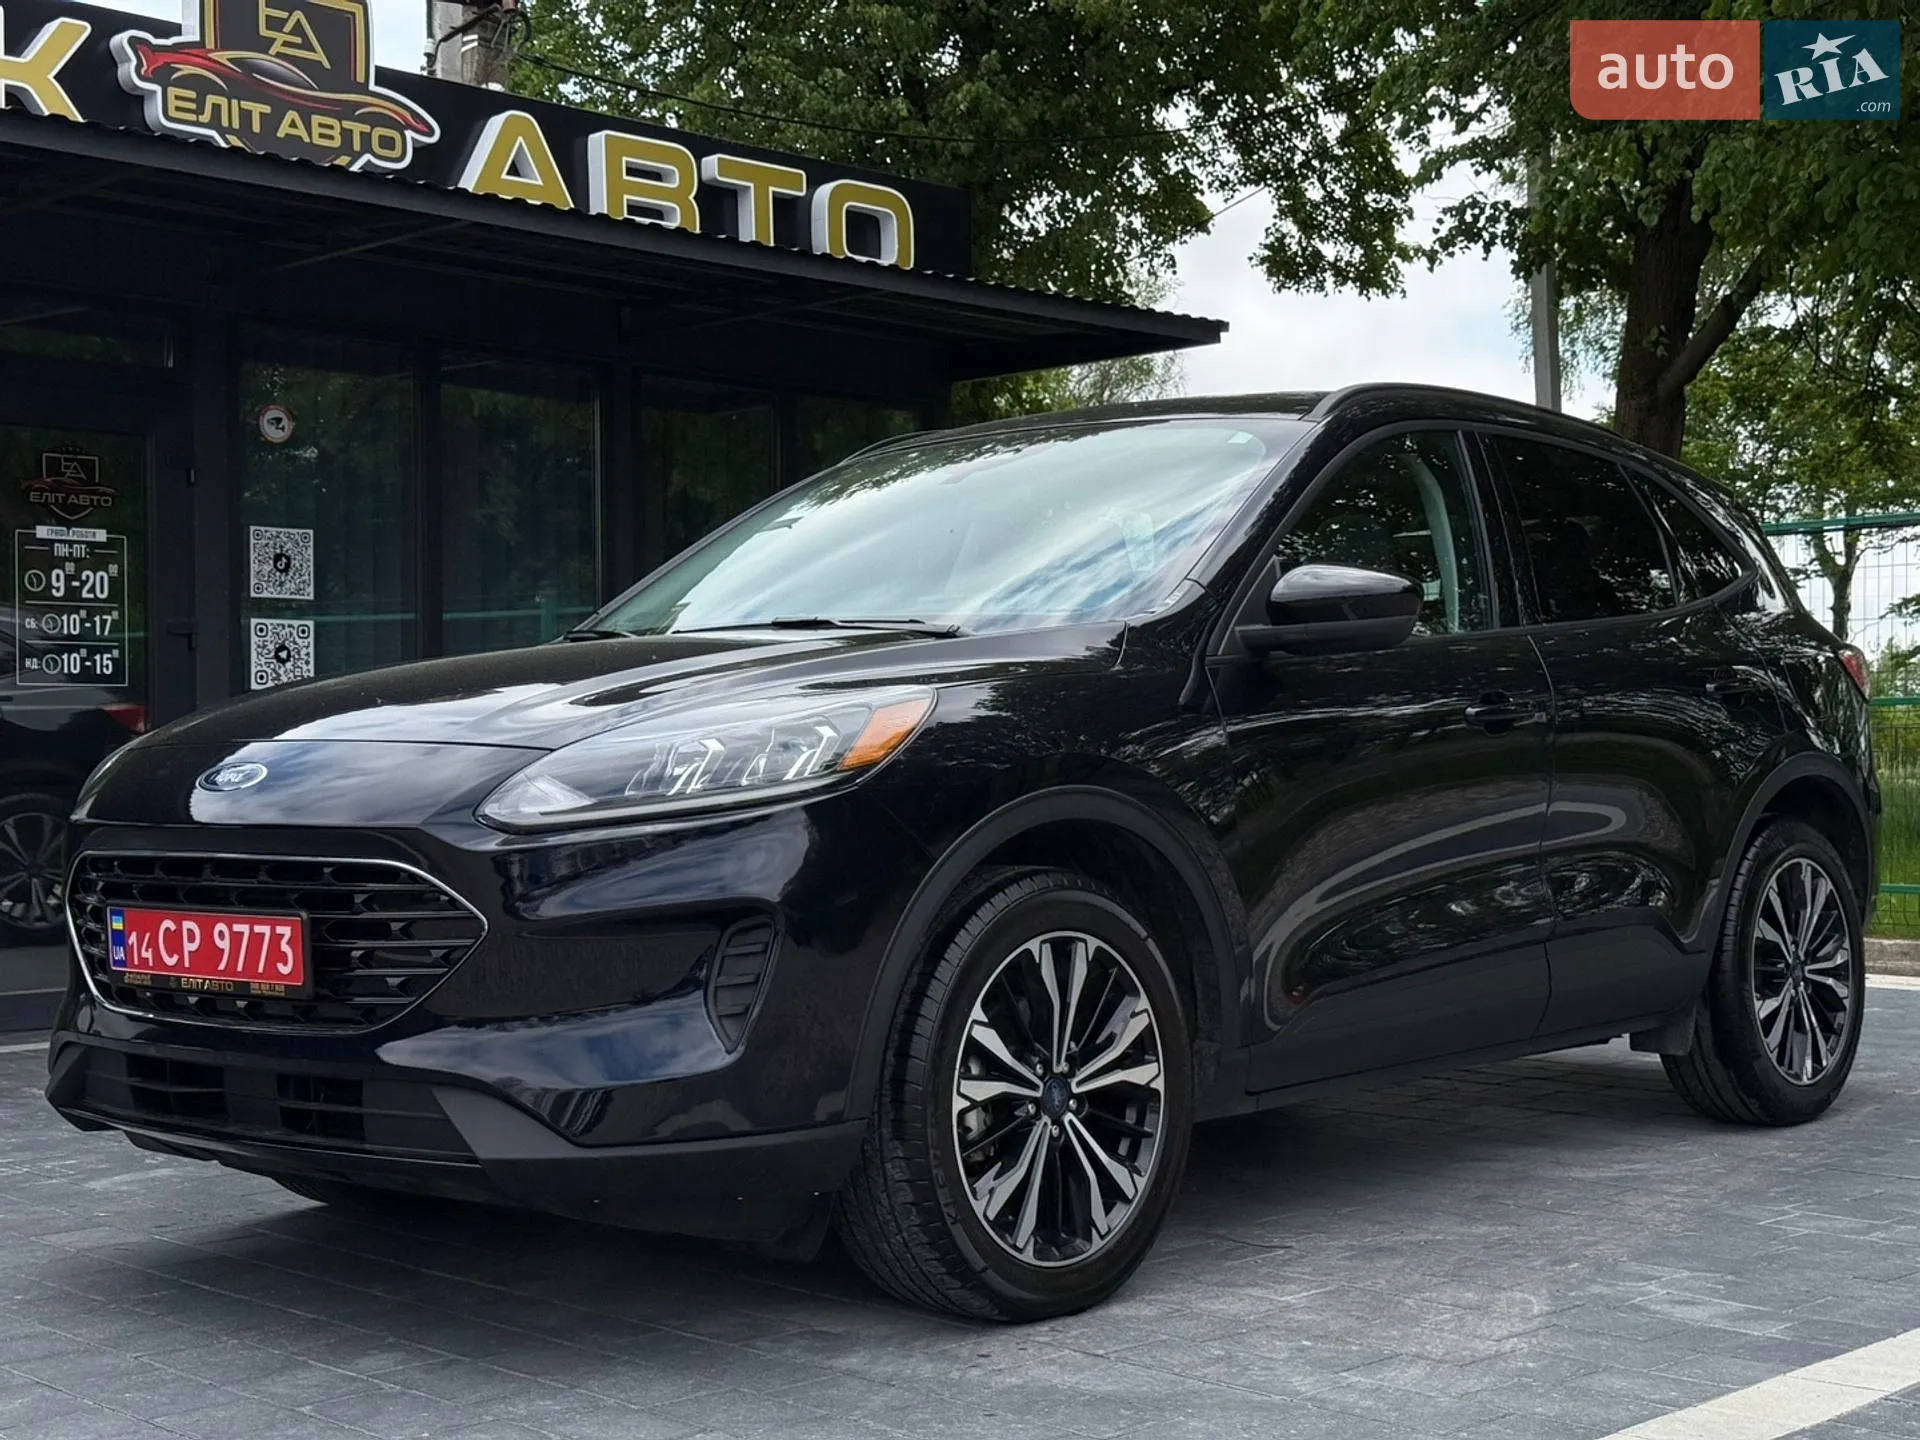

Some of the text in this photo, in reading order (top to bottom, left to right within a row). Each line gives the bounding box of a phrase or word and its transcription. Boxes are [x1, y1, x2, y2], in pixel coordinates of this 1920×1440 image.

[167, 85, 406, 159] ЕЛІТ АВТО
[457, 110, 915, 270] АВТО
[29, 491, 113, 507] ЕЛІТ АВТО
[112, 945, 126, 961] UA
[213, 922, 295, 975] 9773
